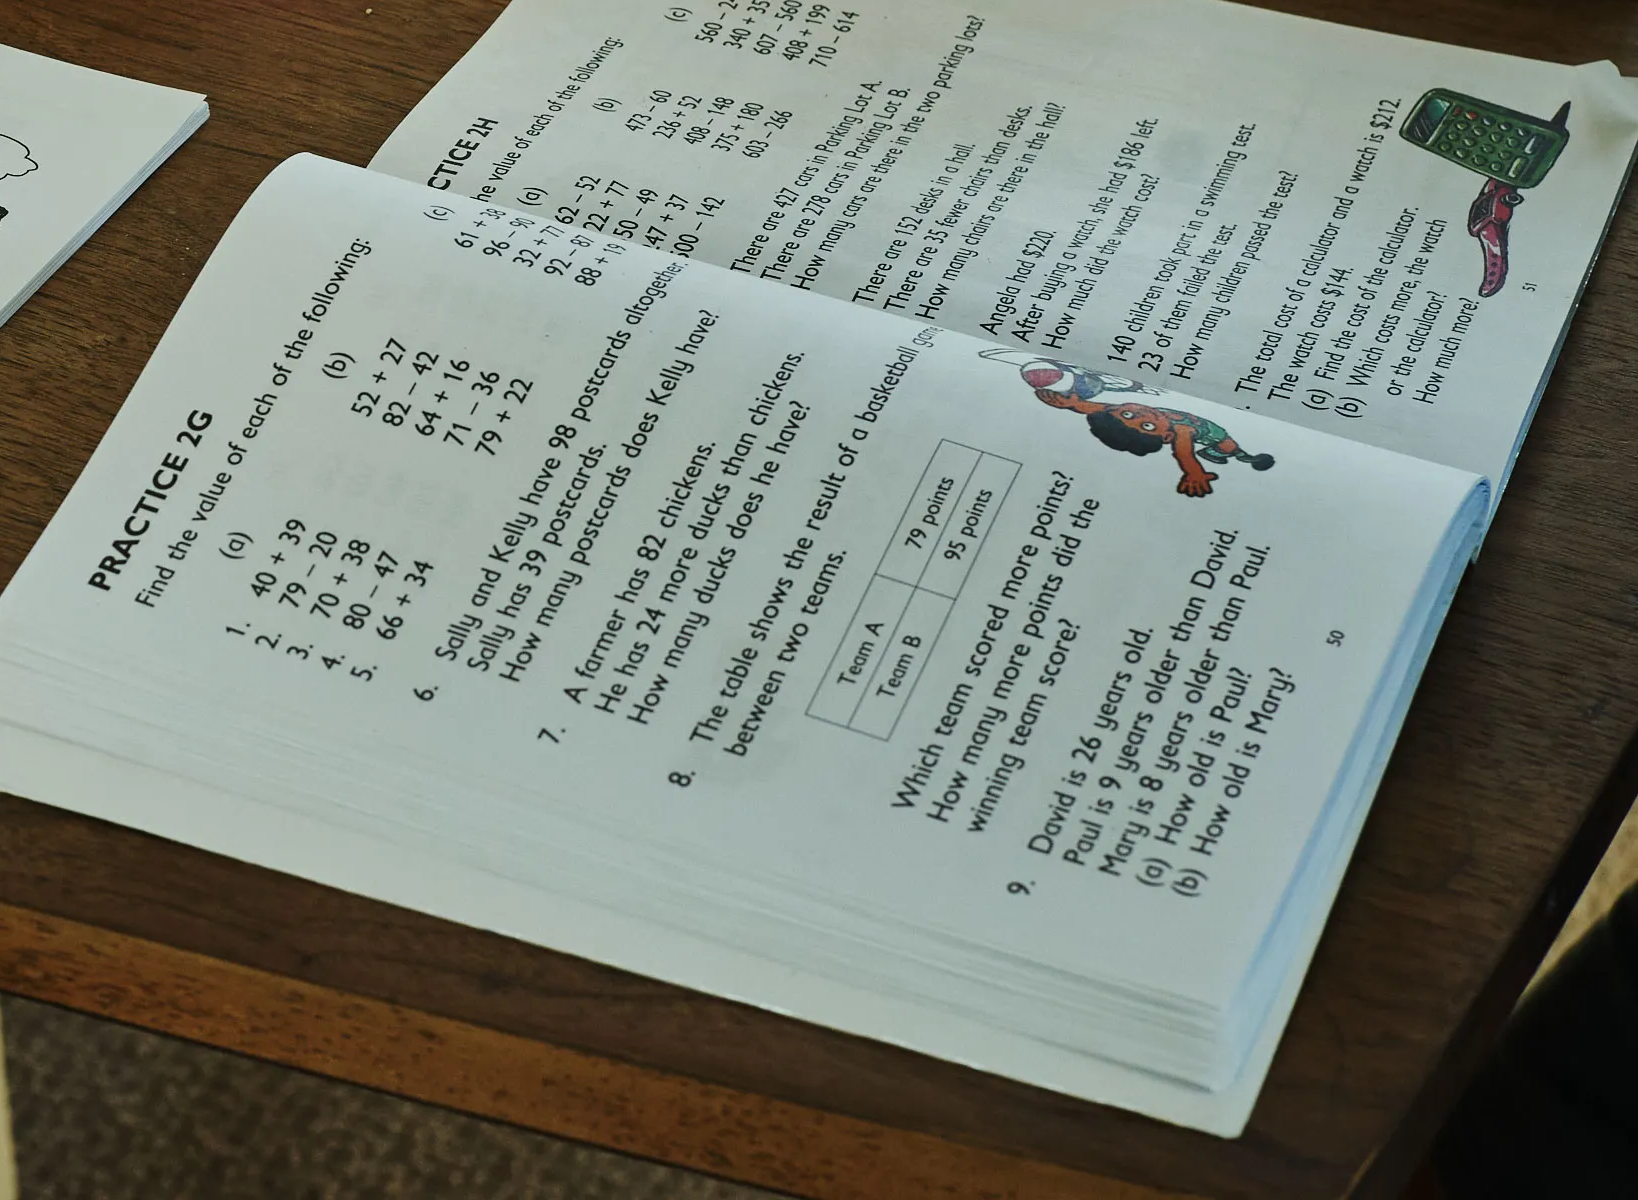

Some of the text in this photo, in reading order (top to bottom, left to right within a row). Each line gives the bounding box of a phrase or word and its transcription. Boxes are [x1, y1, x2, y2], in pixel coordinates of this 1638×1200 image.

[728, 80, 883, 273] There are 427 cars in Parking Lot A.
[850, 142, 976, 303] There are 152 desks in a hall.
[1105, 122, 1256, 362] 140 children took part in a swimming test.
[1233, 97, 1402, 393] The total cost of a calculator and a watch is $212.
[978, 229, 1057, 336] Angela had $220.
[1520, 281, 1538, 292] 51
[133, 237, 372, 608] Find the value of each of the following:
[349, 390, 381, 418] 52
[378, 336, 407, 366] 27
[86, 408, 213, 592] PRACTICE 2G
[224, 622, 251, 636] 1.
[249, 570, 278, 598] 40
[277, 518, 306, 546] 39
[903, 476, 954, 549] 79 points
[942, 488, 993, 561] 95 points
[536, 441, 716, 744] 7. A farmer has 82 chickens.
[835, 622, 885, 684] Team A
[874, 634, 922, 697] Team B
[890, 469, 1074, 808] Which team scored more points?
[1324, 628, 1346, 647] 50
[1005, 627, 1154, 895] 9. David is 26 years old.
[1170, 666, 1296, 898] (b) How old is Mary?
